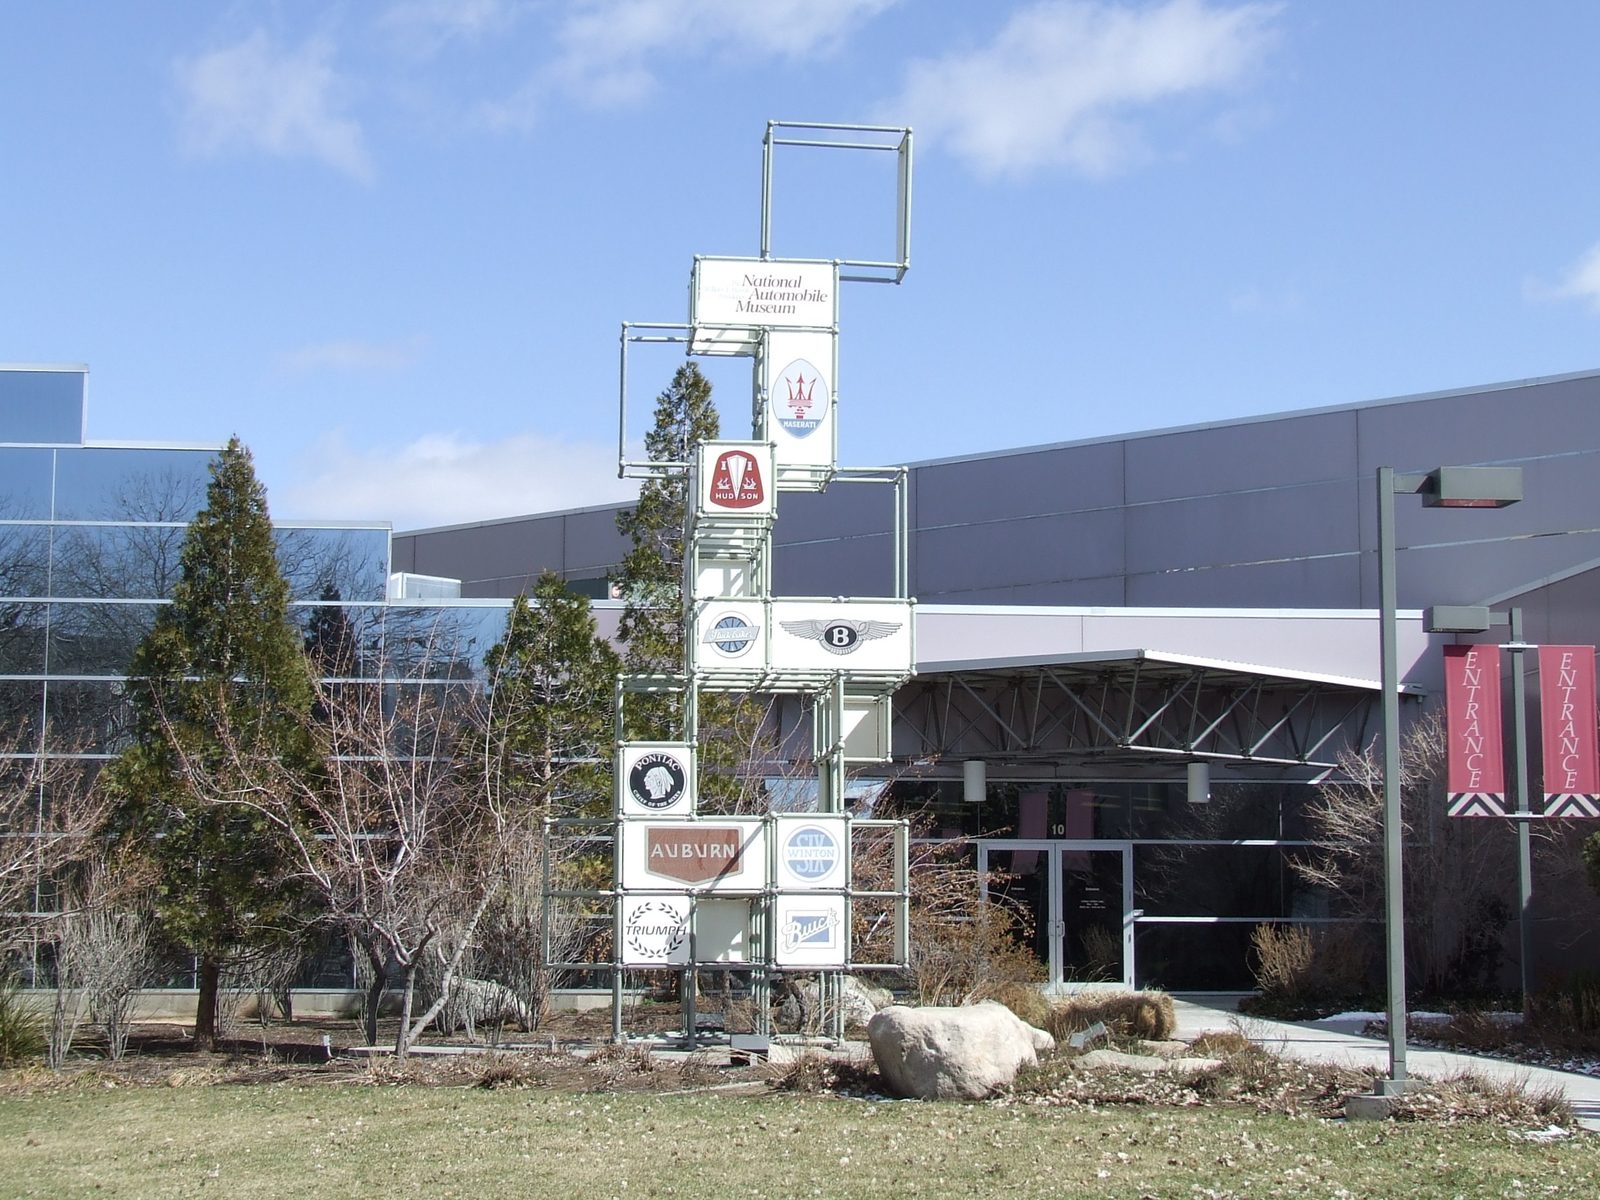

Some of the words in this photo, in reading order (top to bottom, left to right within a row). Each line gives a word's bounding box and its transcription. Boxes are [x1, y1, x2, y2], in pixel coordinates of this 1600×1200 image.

[742, 274, 802, 288] National
[748, 288, 828, 303] Automobile
[735, 300, 796, 314] Museum
[783, 420, 816, 429] MASERATI
[831, 627, 849, 646] B
[1462, 651, 1484, 788] ENTRANCE
[1556, 652, 1579, 789] ENTRANCE
[635, 753, 680, 771] PONTIAC
[1051, 824, 1065, 835] 10
[650, 842, 736, 859] AUBURN
[788, 848, 835, 858] WINTON
[625, 926, 687, 936] TRIUMPH
[780, 907, 840, 954] Buick
